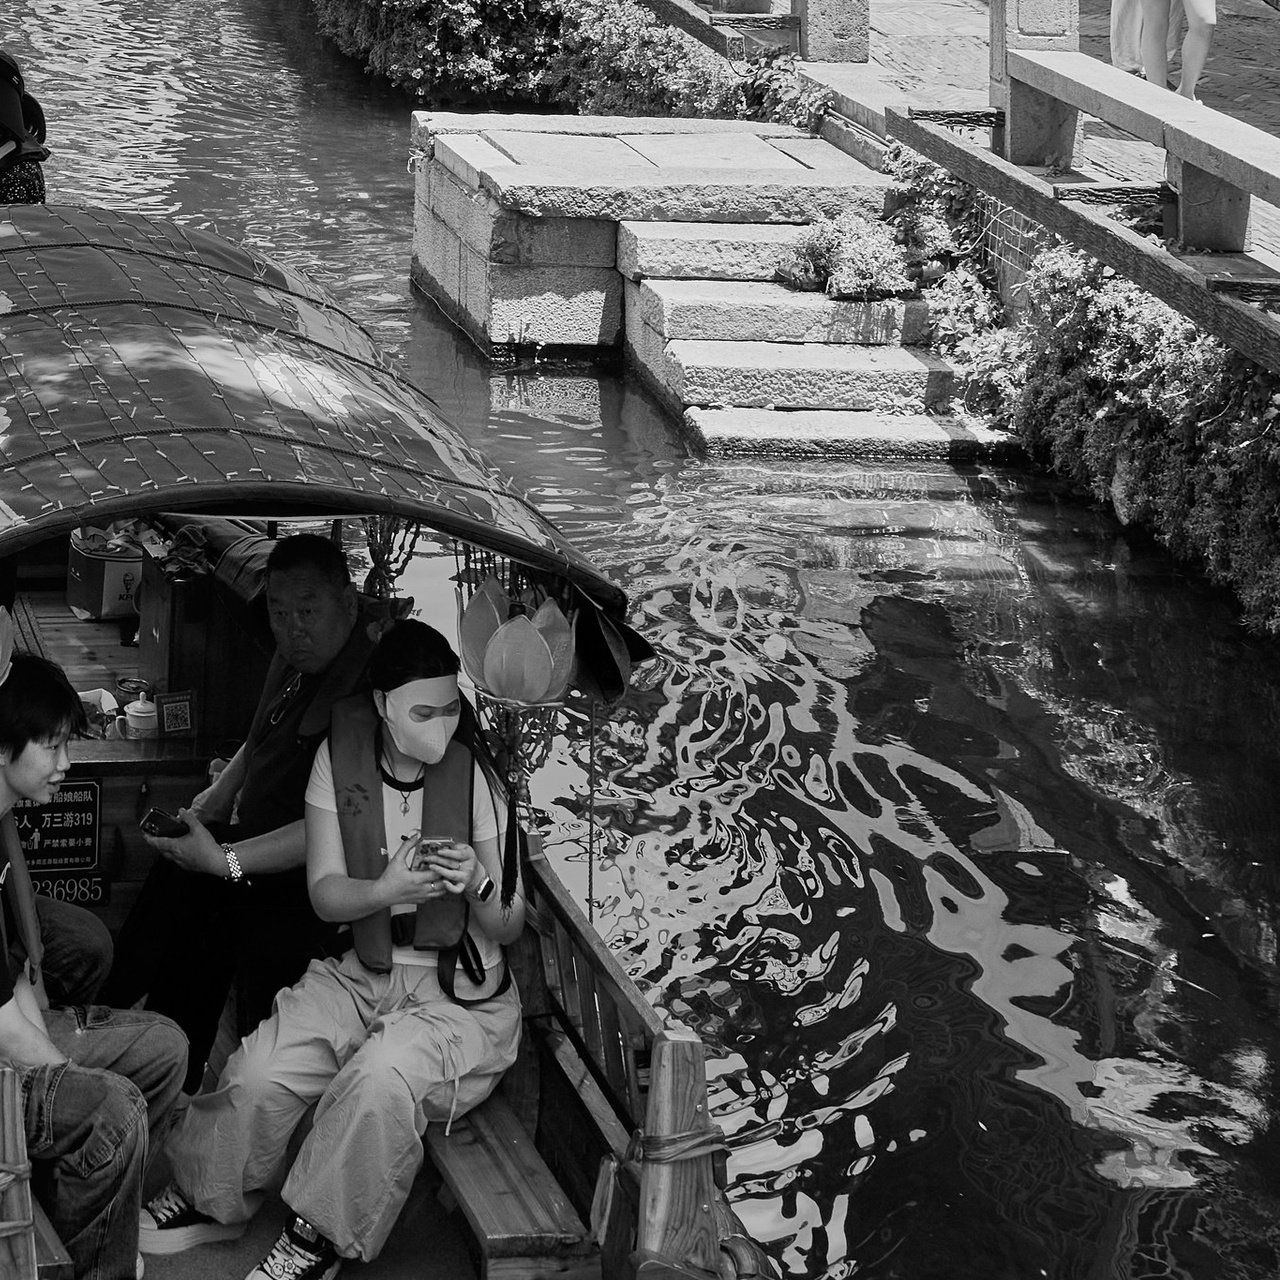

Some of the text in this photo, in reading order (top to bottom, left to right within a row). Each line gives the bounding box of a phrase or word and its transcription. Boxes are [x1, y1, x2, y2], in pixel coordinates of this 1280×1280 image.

[41, 811, 93, 829] 万三游319
[43, 837, 92, 849] 严禁索要小费
